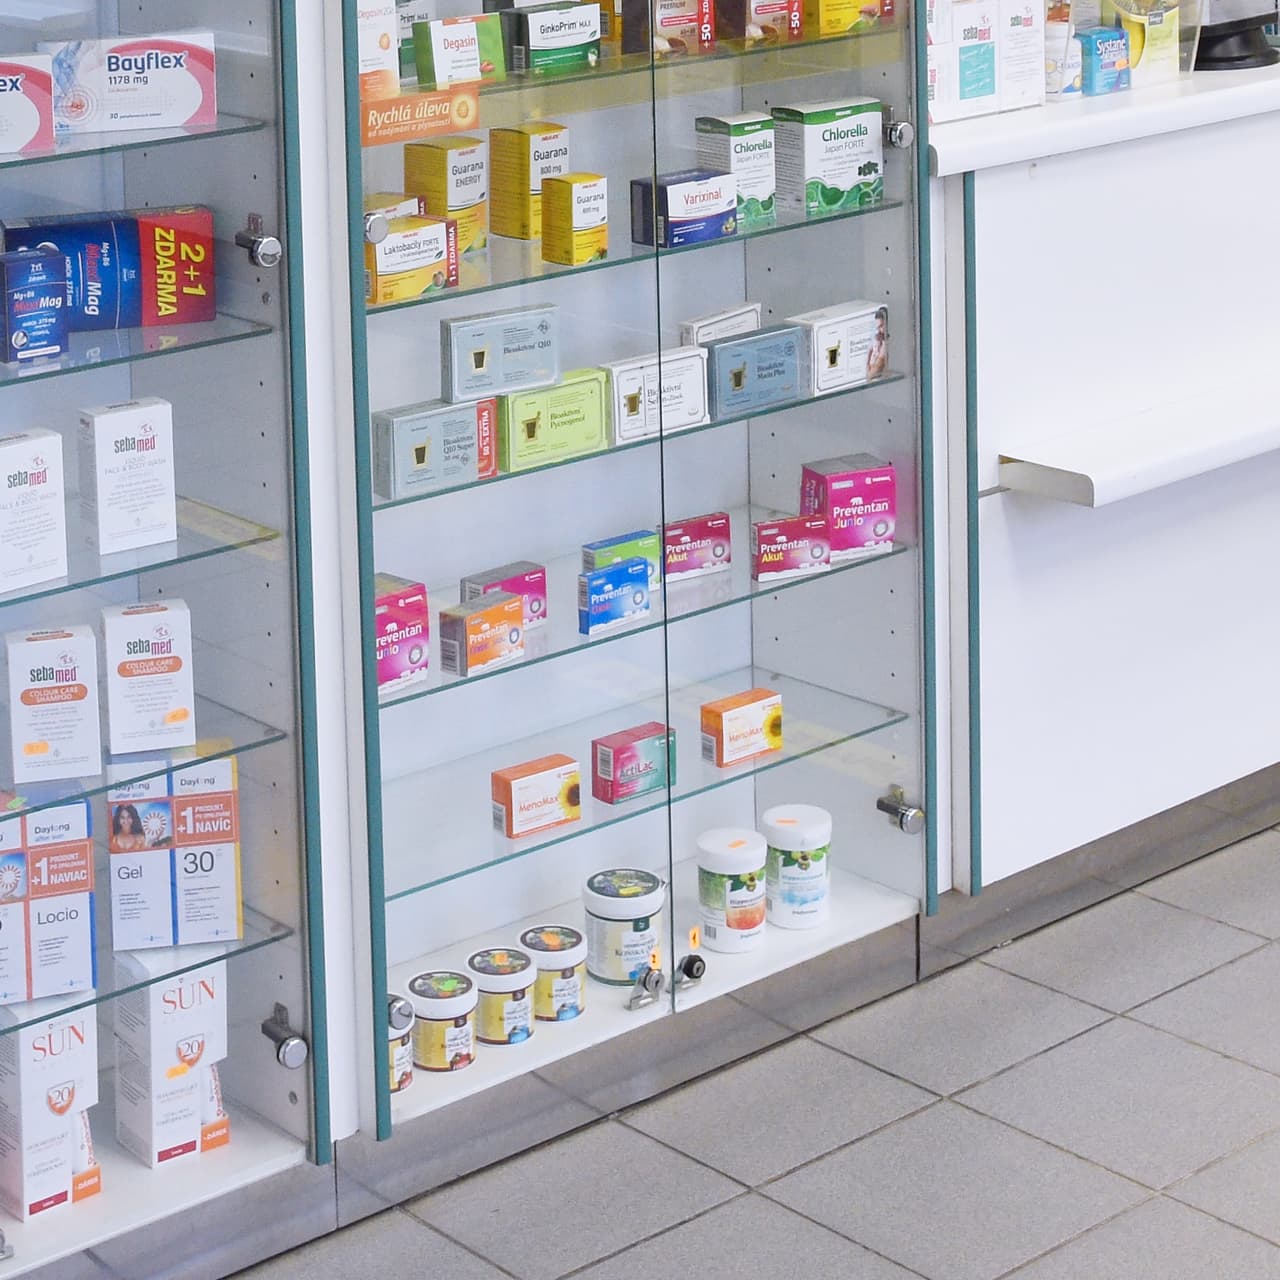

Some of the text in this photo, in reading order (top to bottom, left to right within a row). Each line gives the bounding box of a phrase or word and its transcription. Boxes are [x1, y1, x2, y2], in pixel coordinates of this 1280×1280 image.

[540, 21, 576, 34] GinkoPrim
[443, 35, 476, 50] Degasin
[1097, 38, 1127, 54] Systane
[108, 52, 185, 74] Bayflex
[109, 75, 148, 86] 1178 mg
[368, 99, 450, 127] Rychlá úleva
[822, 124, 867, 141] Chlorella
[533, 147, 568, 161] Guarana
[452, 161, 484, 175] Guarana
[577, 192, 604, 204] Guarana
[684, 188, 721, 204] Varixinal
[155, 227, 176, 316] ZDARMA
[180, 243, 206, 297] 2+1
[833, 502, 888, 517] Preventan
[761, 538, 809, 553] Preventan
[762, 552, 784, 564] Akut
[592, 586, 632, 603] Preventan
[470, 624, 508, 643] Preventan
[127, 638, 172, 656] sebamed
[30, 666, 77, 683] sebamed
[519, 796, 559, 812] MenoMax
[184, 852, 214, 874] 30
[118, 866, 142, 880] Gel
[37, 908, 78, 925] Locio
[162, 977, 214, 1015] SUN
[32, 1020, 86, 1062] SUN
[183, 1040, 200, 1056] 20
[53, 1088, 70, 1104] 20
